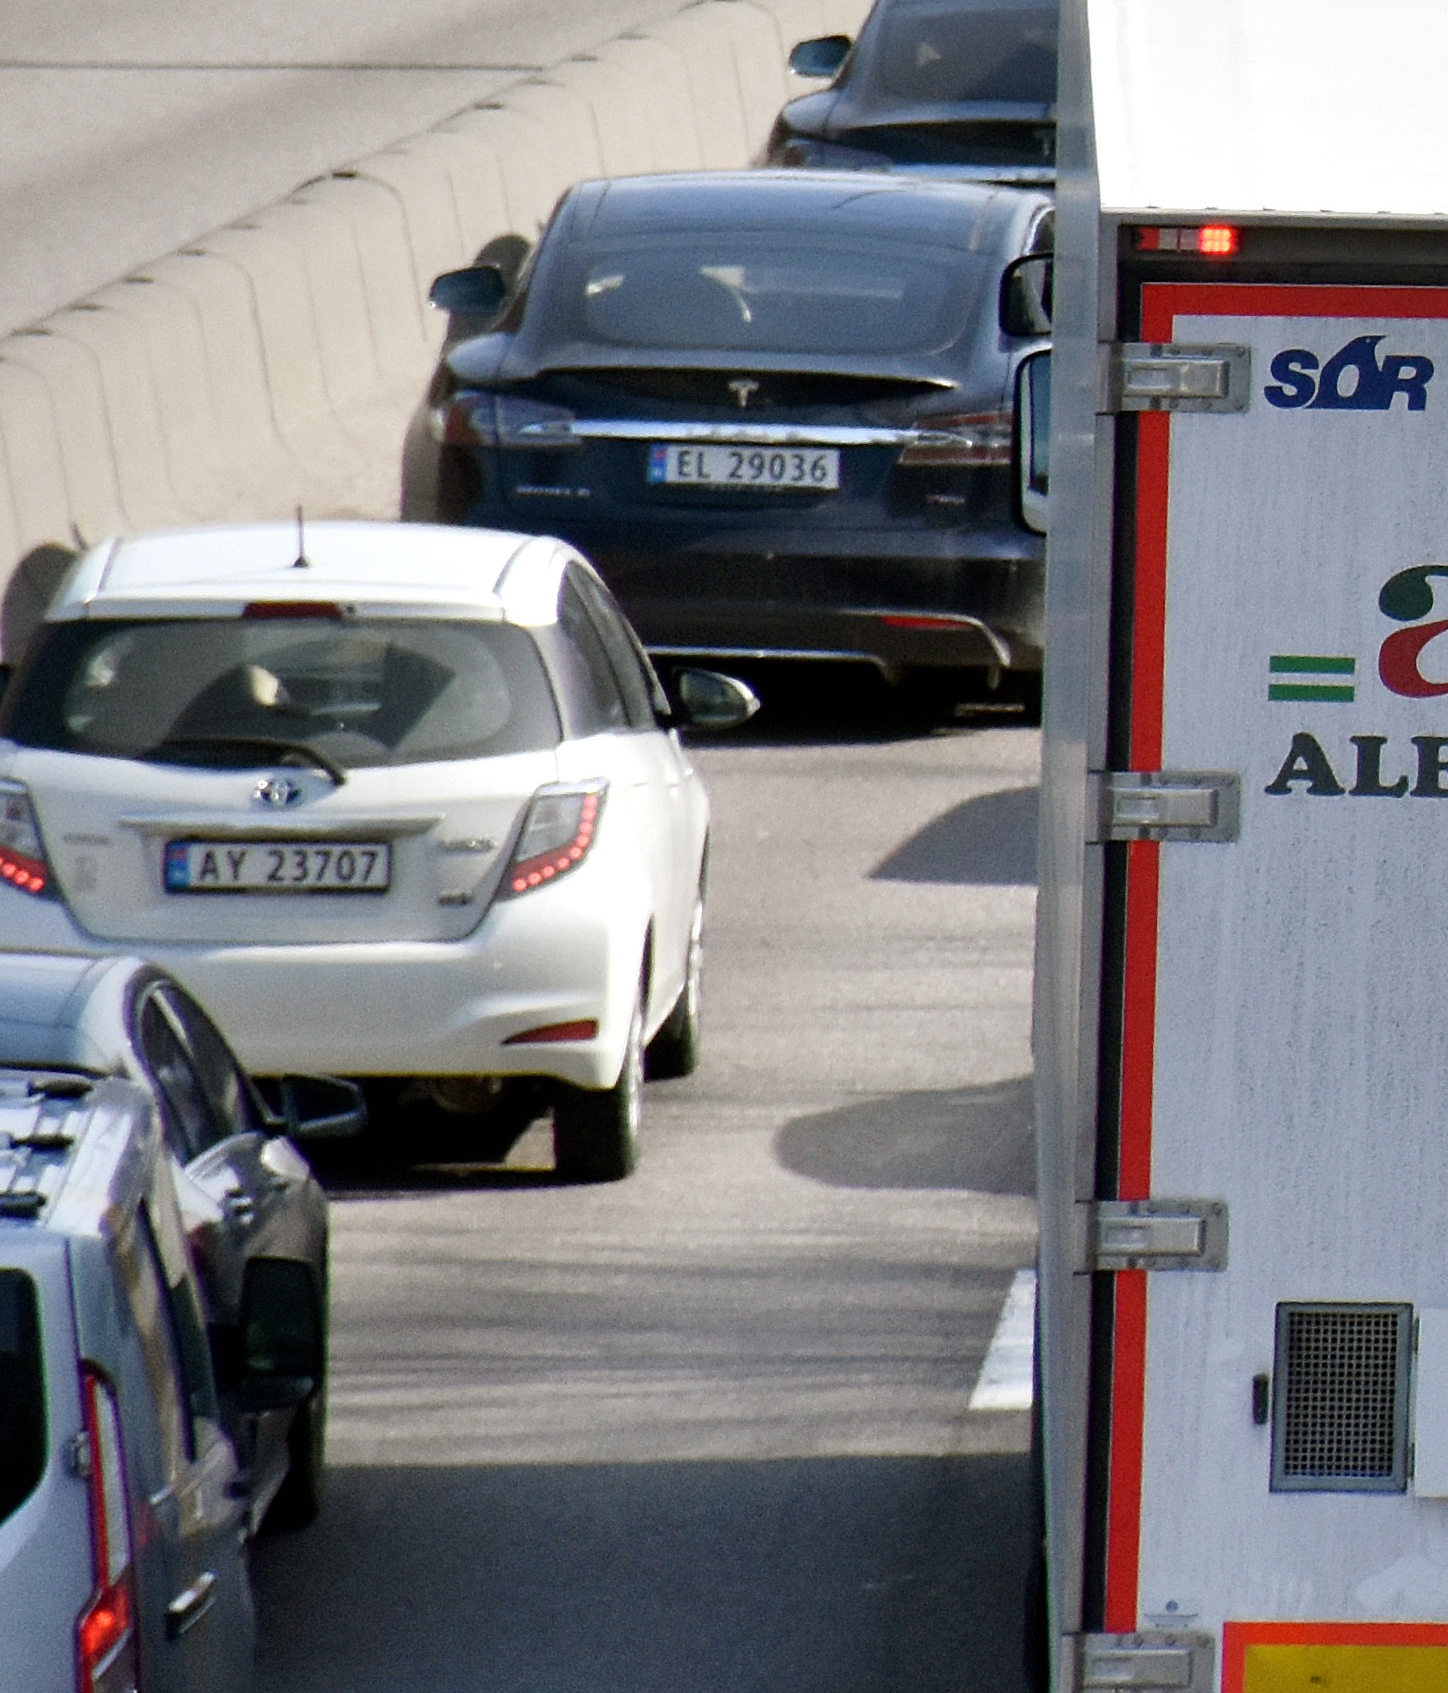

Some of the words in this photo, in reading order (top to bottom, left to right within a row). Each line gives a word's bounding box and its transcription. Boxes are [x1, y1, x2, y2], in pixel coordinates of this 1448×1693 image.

[676, 449, 712, 480] EL
[728, 450, 828, 484] 29036
[199, 850, 247, 881] AY
[266, 849, 381, 884] 23707
